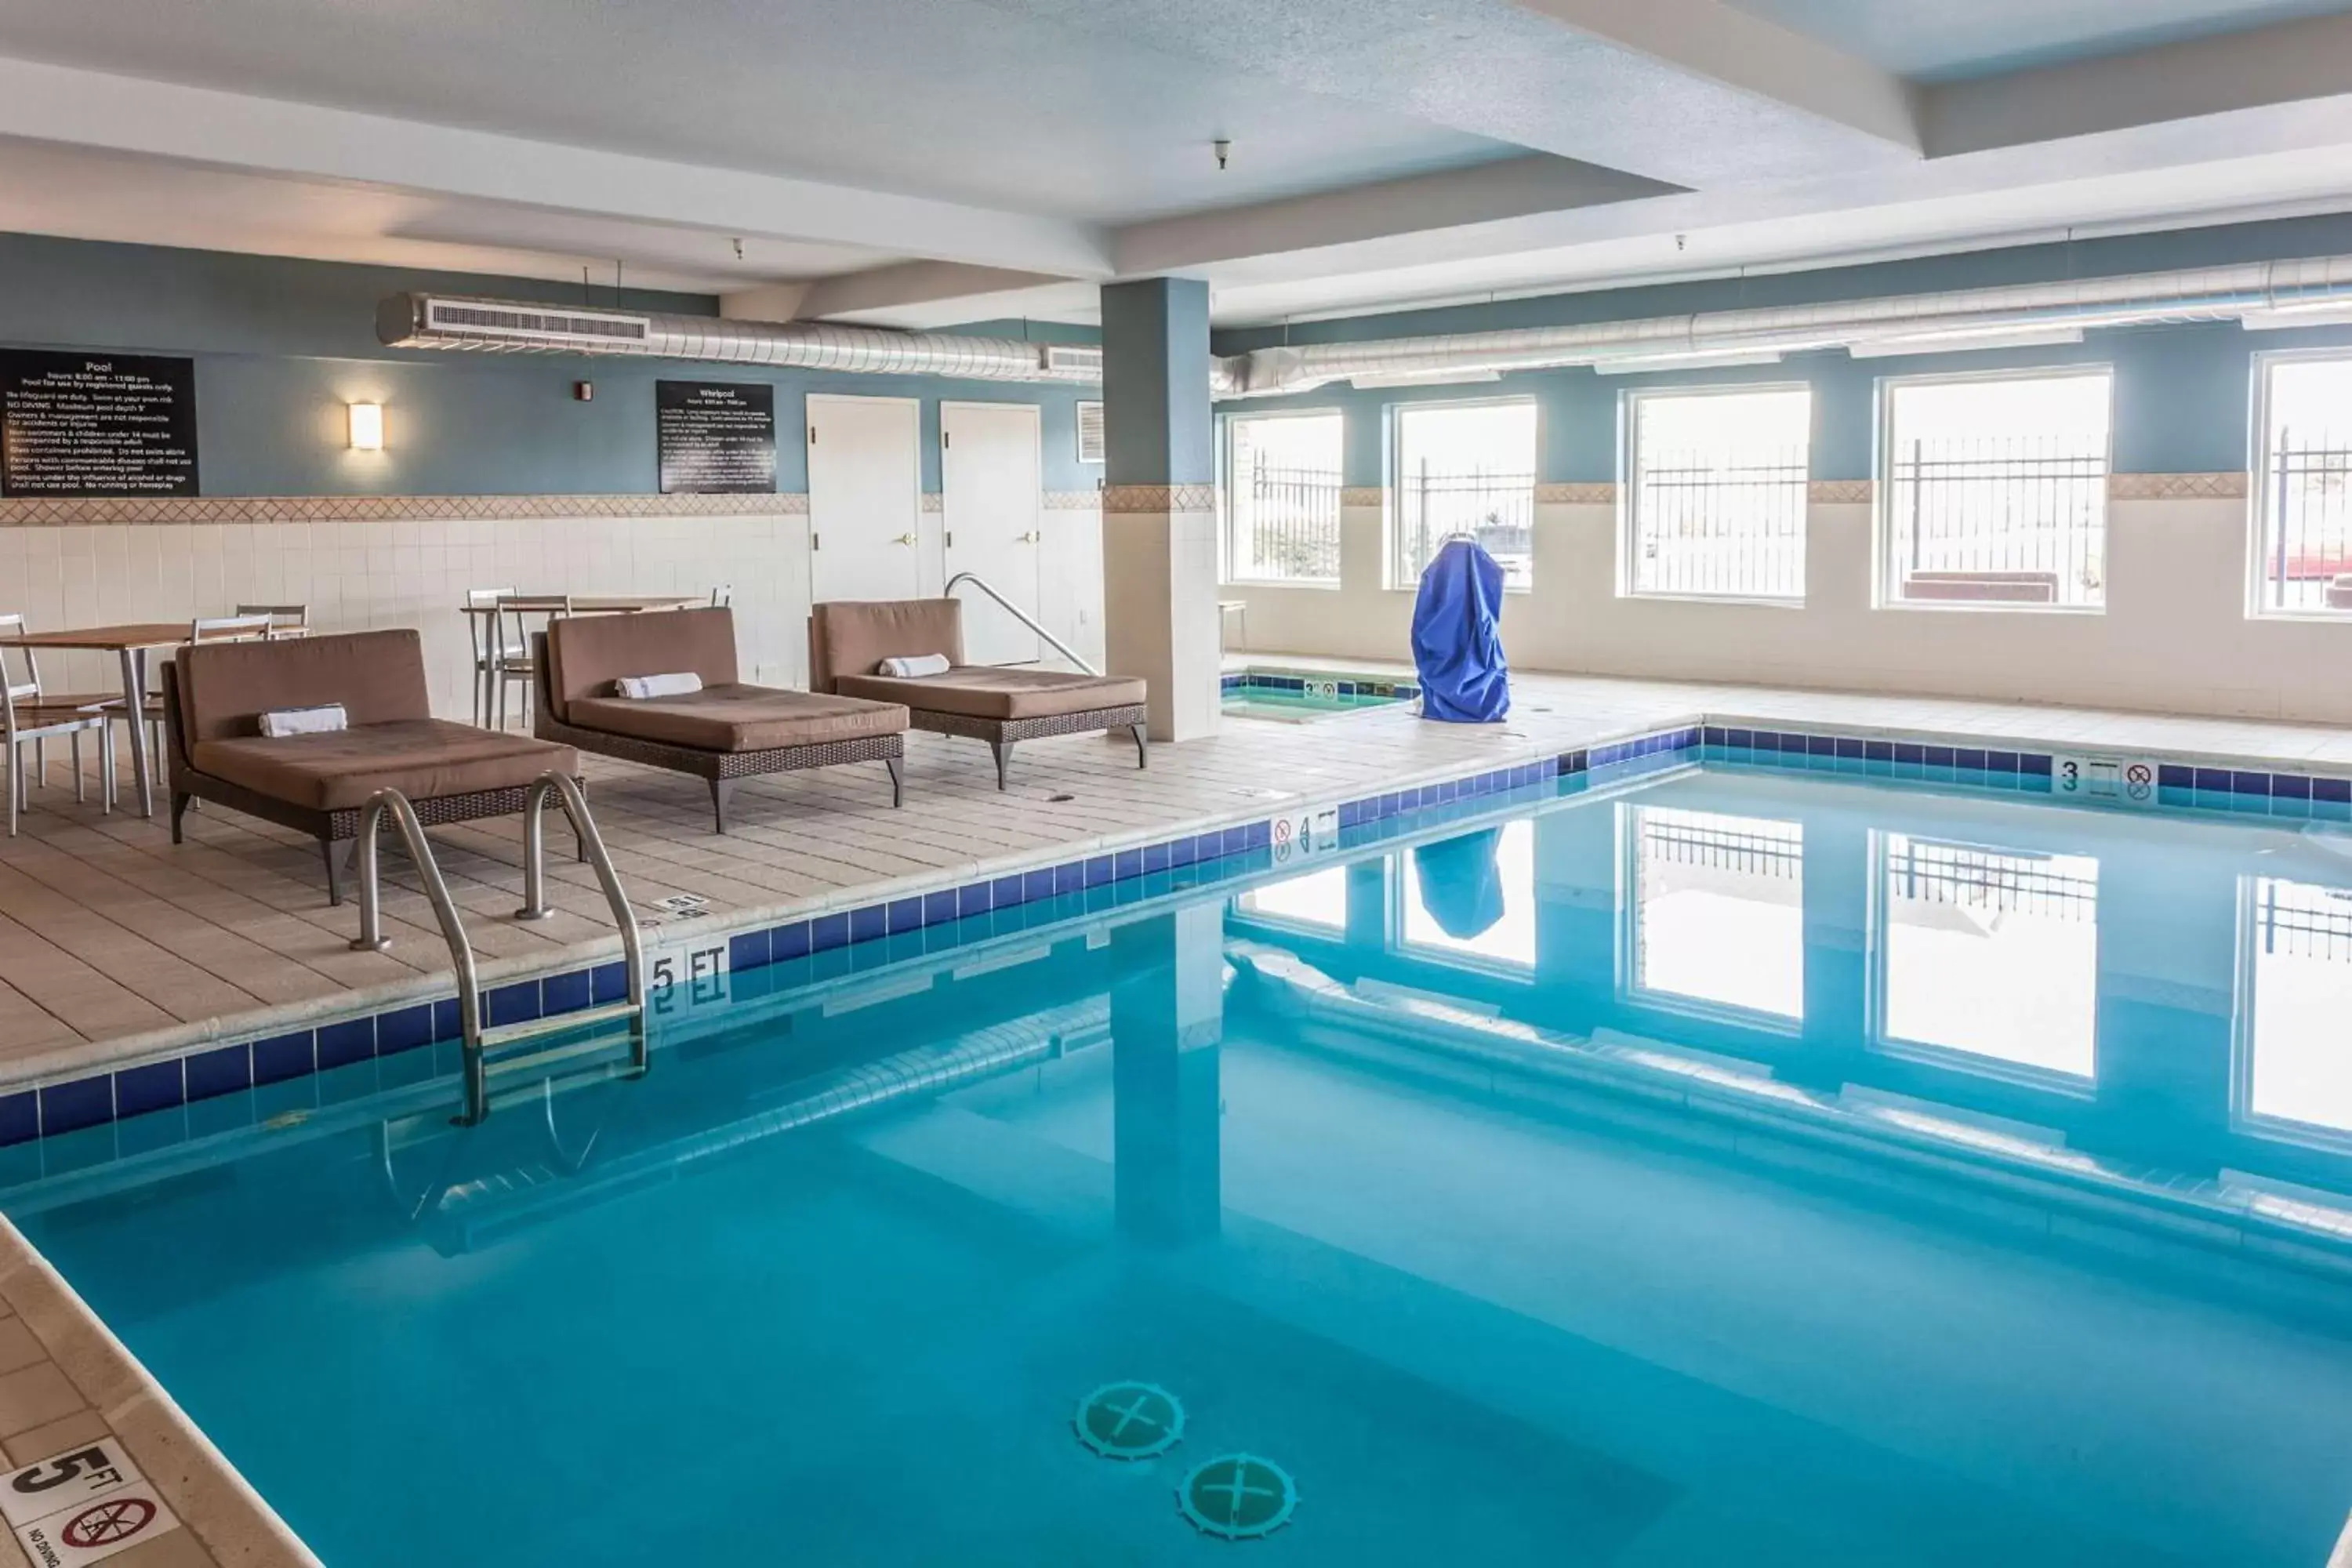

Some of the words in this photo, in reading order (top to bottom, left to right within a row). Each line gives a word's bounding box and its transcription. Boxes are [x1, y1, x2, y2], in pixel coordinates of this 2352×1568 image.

[85, 362, 112, 372] Pool
[699, 390, 735, 398] Whirlpool
[1299, 816, 1309, 835] 4
[653, 957, 673, 990] 5
[691, 946, 724, 982] FT
[12, 1446, 111, 1494] 5
[82, 1467, 123, 1490] FT
[28, 1527, 45, 1542] NO
